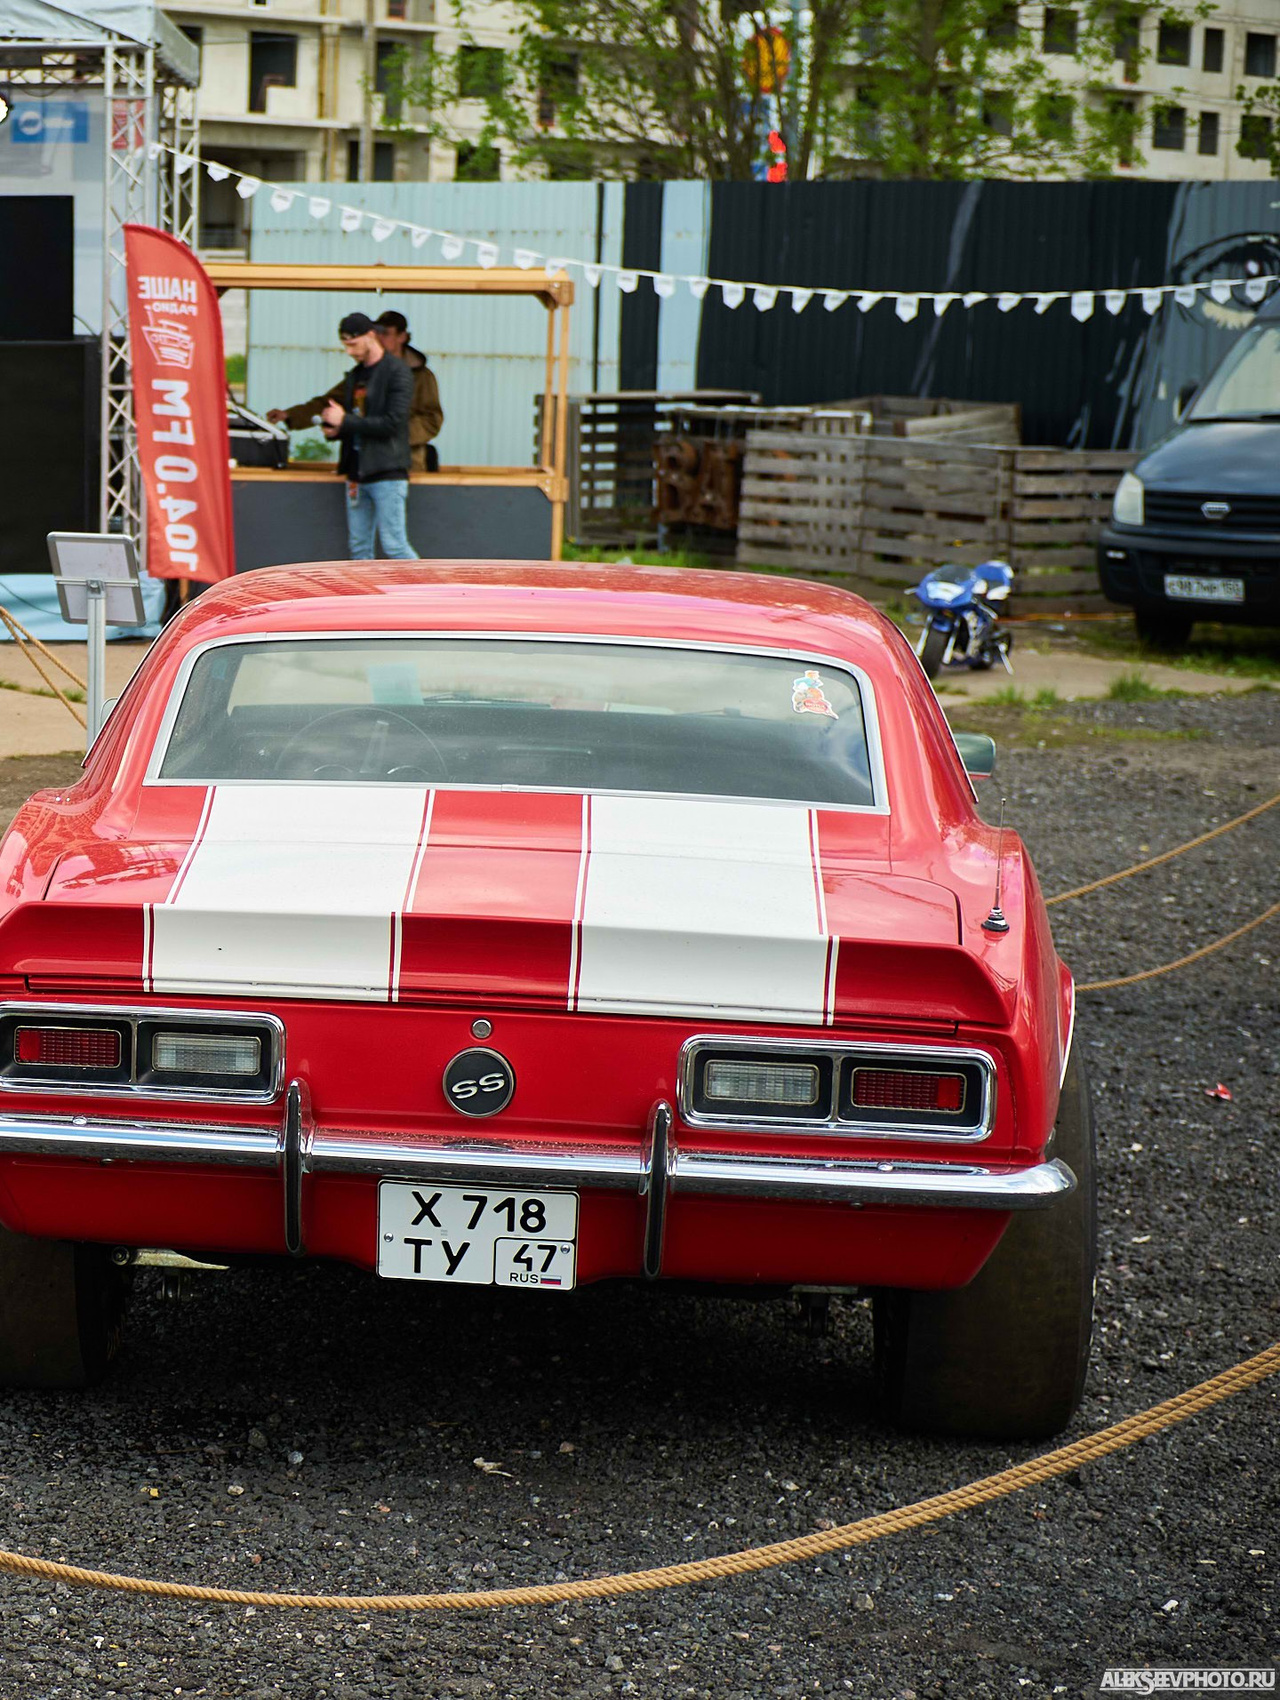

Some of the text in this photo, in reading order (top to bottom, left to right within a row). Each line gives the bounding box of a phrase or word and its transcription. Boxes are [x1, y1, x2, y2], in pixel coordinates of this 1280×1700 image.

[452, 1073, 505, 1099] SS
[411, 1191, 546, 1233] Х 718
[403, 1237, 470, 1275] ТУ
[513, 1244, 557, 1272] 47
[509, 1272, 538, 1283] RUS
